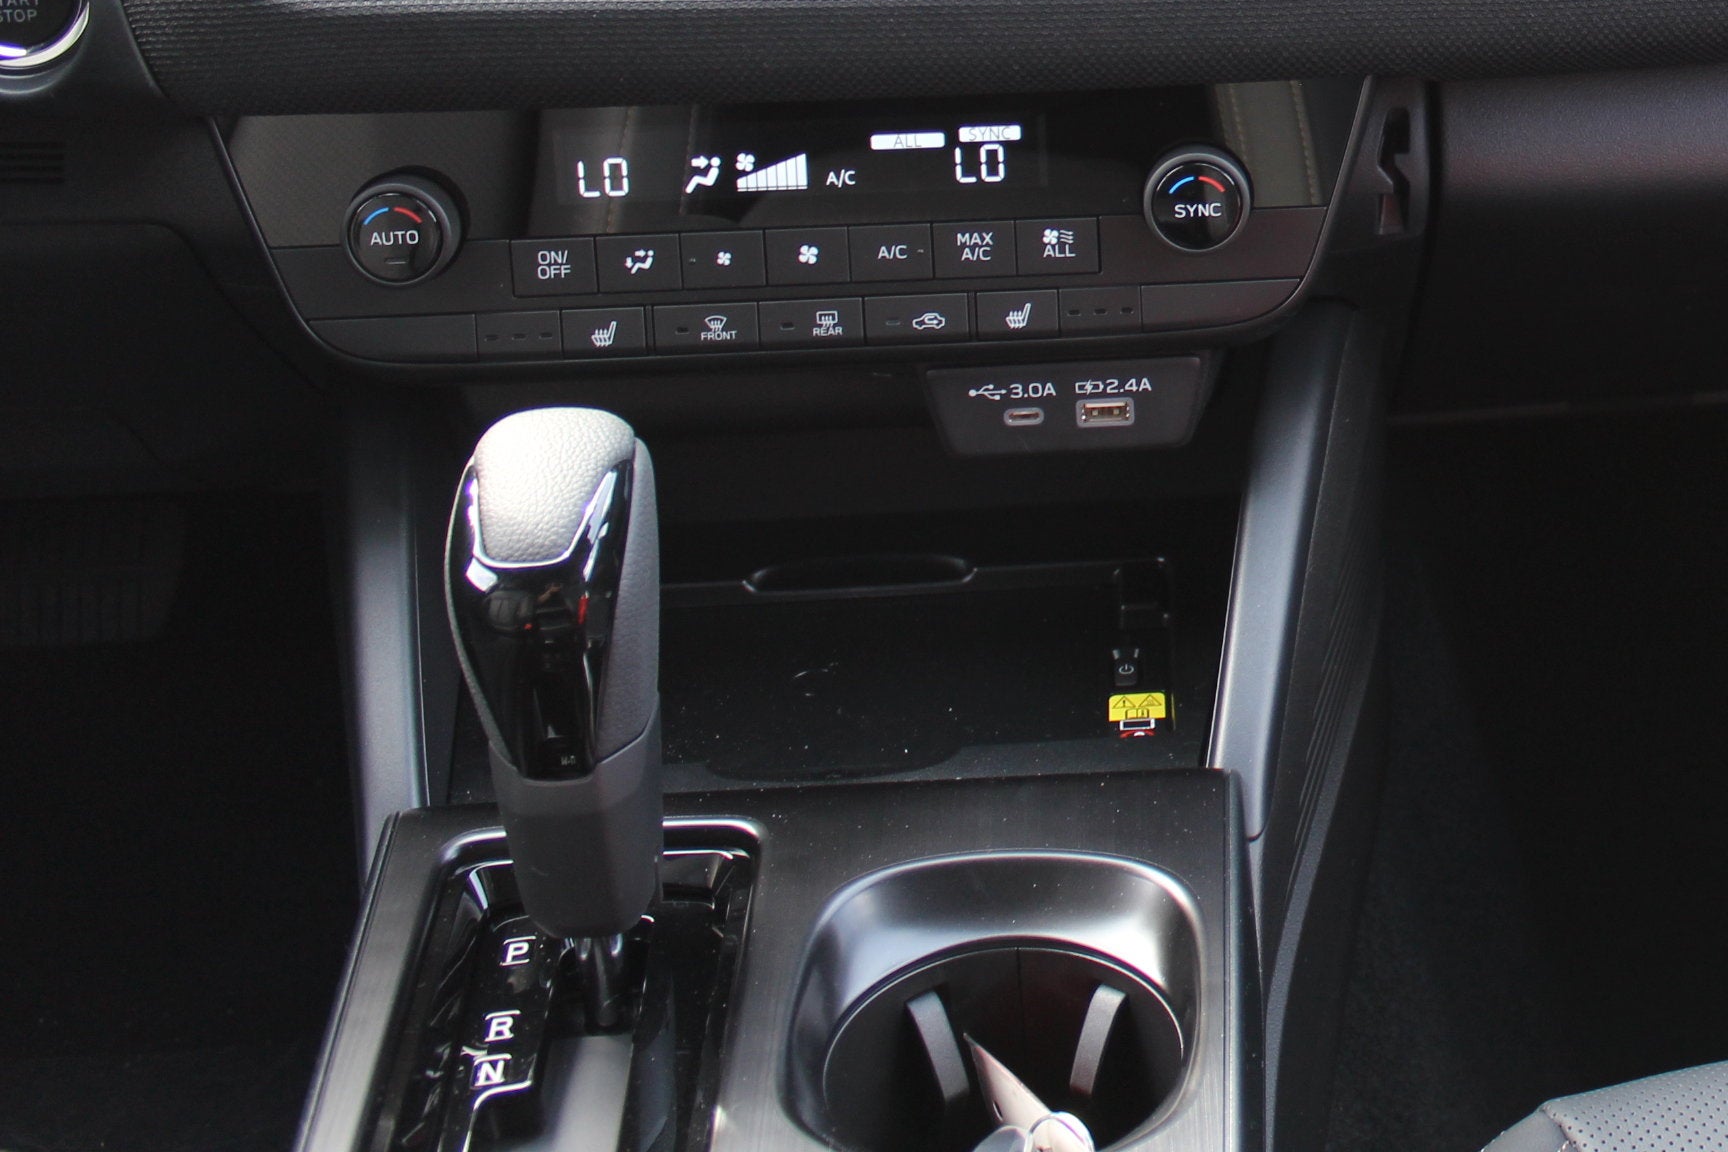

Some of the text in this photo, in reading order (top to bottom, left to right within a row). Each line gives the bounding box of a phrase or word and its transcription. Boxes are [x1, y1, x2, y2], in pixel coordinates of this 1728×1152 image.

[893, 135, 922, 148] ALL
[969, 127, 1012, 141] SYNC
[826, 169, 856, 188] A/C
[1174, 203, 1222, 218] SYNC
[370, 230, 419, 247] AUTO
[956, 232, 994, 246] MAX
[538, 250, 568, 265] ON/
[877, 245, 907, 260] A/C
[961, 247, 991, 261] A/C
[1043, 244, 1076, 258] ALL
[538, 265, 571, 279] OFF
[701, 330, 737, 340] FRONT
[813, 326, 843, 337] REAR
[1010, 382, 1056, 398] 3.0A
[1106, 378, 1152, 393] 2.4A
[506, 941, 529, 964] P
[488, 1015, 514, 1040] R
[477, 1060, 505, 1086] N
